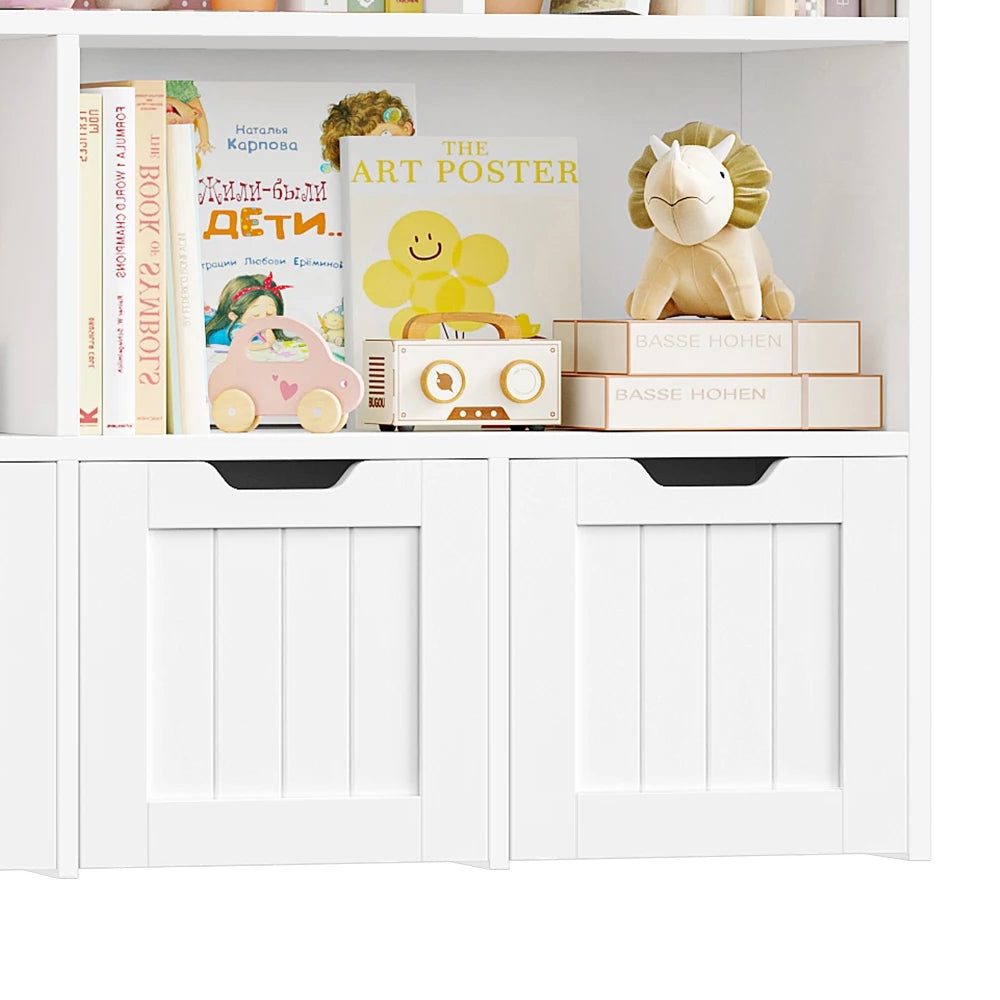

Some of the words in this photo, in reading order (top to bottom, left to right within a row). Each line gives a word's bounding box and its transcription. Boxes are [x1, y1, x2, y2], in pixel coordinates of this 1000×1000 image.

[235, 124, 288, 135] Наталья
[227, 138, 299, 154] Карпова
[442, 140, 489, 156] THE
[351, 159, 422, 184] ART
[437, 159, 579, 184] POSTER
[198, 176, 328, 205] Жили-были
[244, 256, 287, 266] Любови
[635, 333, 700, 348] BASSE
[709, 333, 782, 348] HOHEN
[615, 388, 682, 401] BASSE
[690, 388, 767, 401] HOHEN
